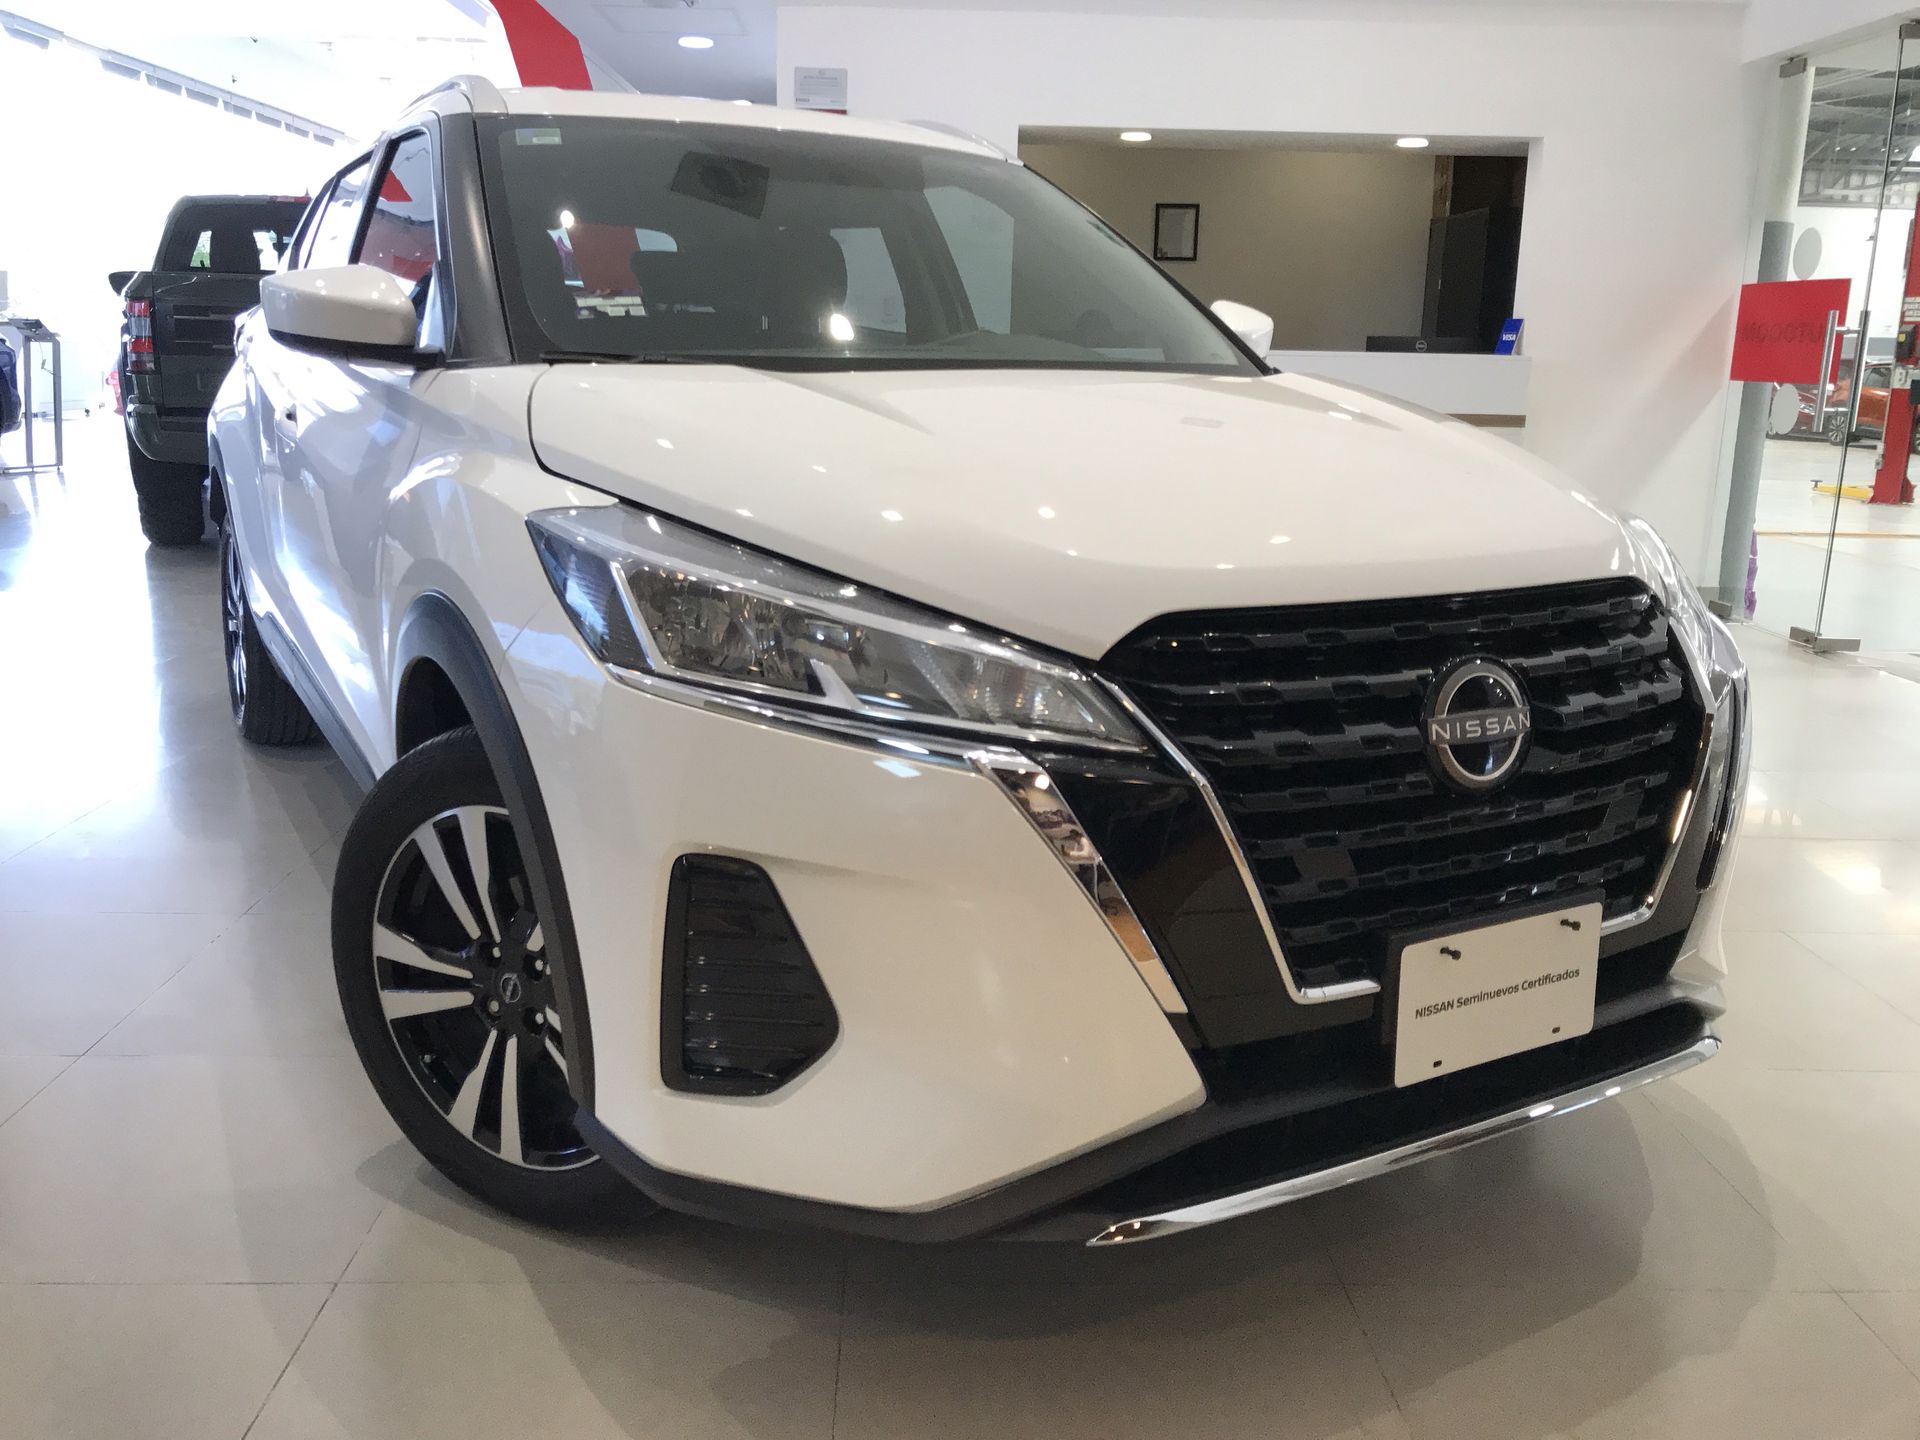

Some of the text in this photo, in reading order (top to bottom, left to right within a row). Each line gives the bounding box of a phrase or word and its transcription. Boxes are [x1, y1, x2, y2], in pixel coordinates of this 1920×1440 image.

[1502, 333, 1516, 341] VISA
[1431, 712, 1530, 740] NISSAN
[1415, 968, 1580, 1019] NISSAN Seminuevos Certificados
